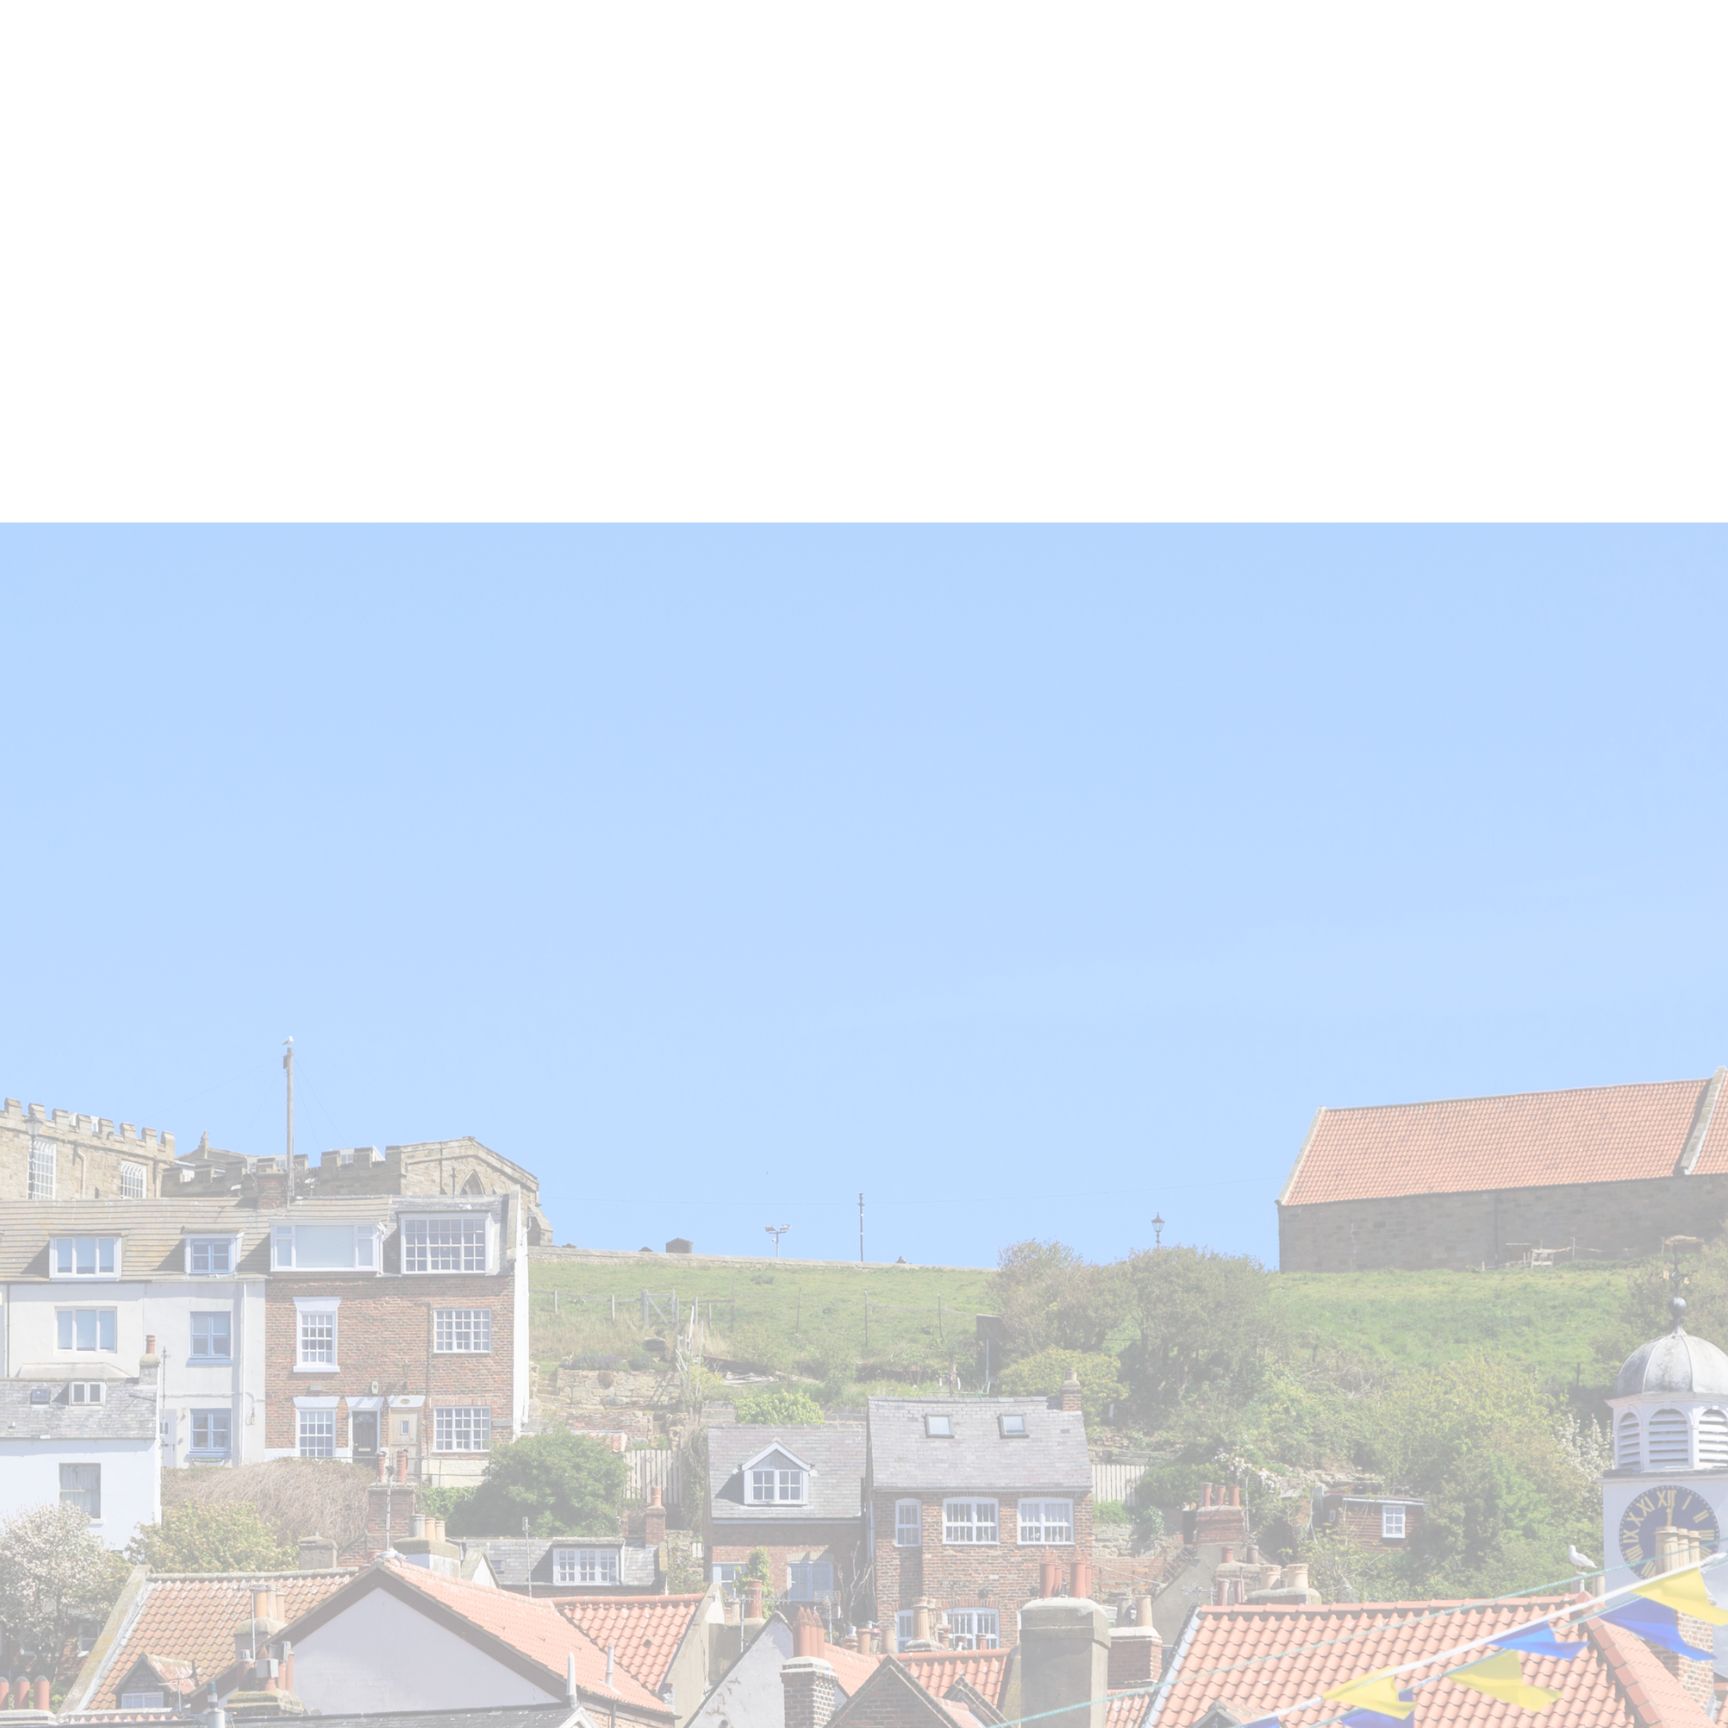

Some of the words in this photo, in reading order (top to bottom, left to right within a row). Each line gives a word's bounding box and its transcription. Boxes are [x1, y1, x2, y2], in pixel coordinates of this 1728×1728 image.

[1636, 1496, 1655, 1516] XI
[1627, 1512, 1645, 1527] X
[1692, 1510, 1710, 1523] II
[1623, 1529, 1639, 1544] IX
